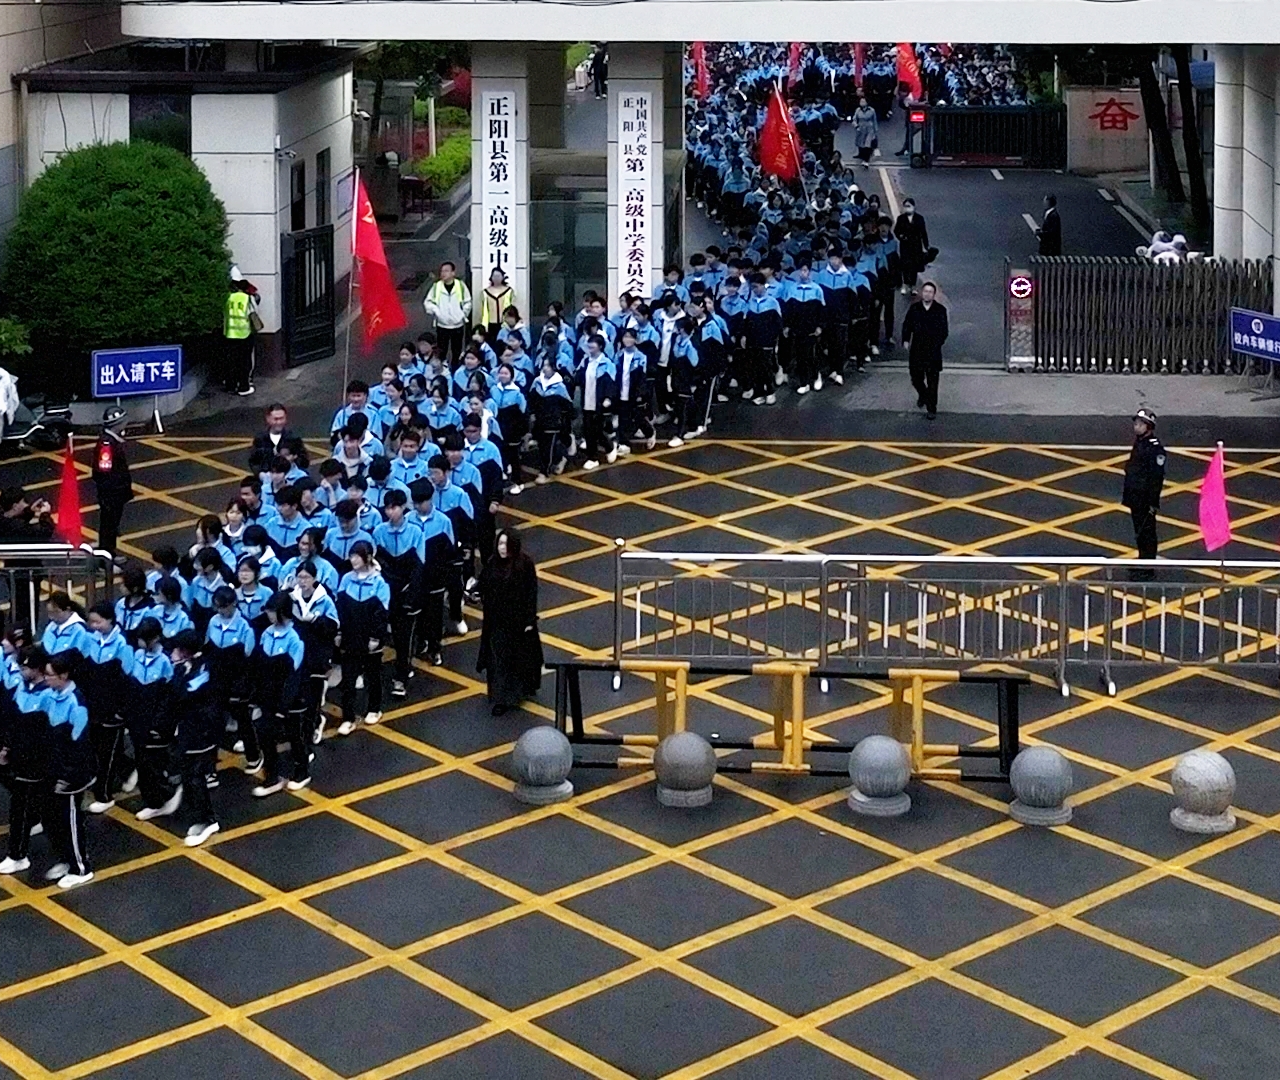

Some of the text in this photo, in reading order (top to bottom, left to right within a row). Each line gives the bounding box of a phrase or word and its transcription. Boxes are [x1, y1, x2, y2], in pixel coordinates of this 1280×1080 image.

[623, 98, 634, 156] 正阳县
[636, 97, 647, 156] 中国共产党
[1089, 97, 1140, 131] 奋
[488, 96, 509, 284] 正阳县第一高级中
[100, 360, 176, 385] 出入请下车
